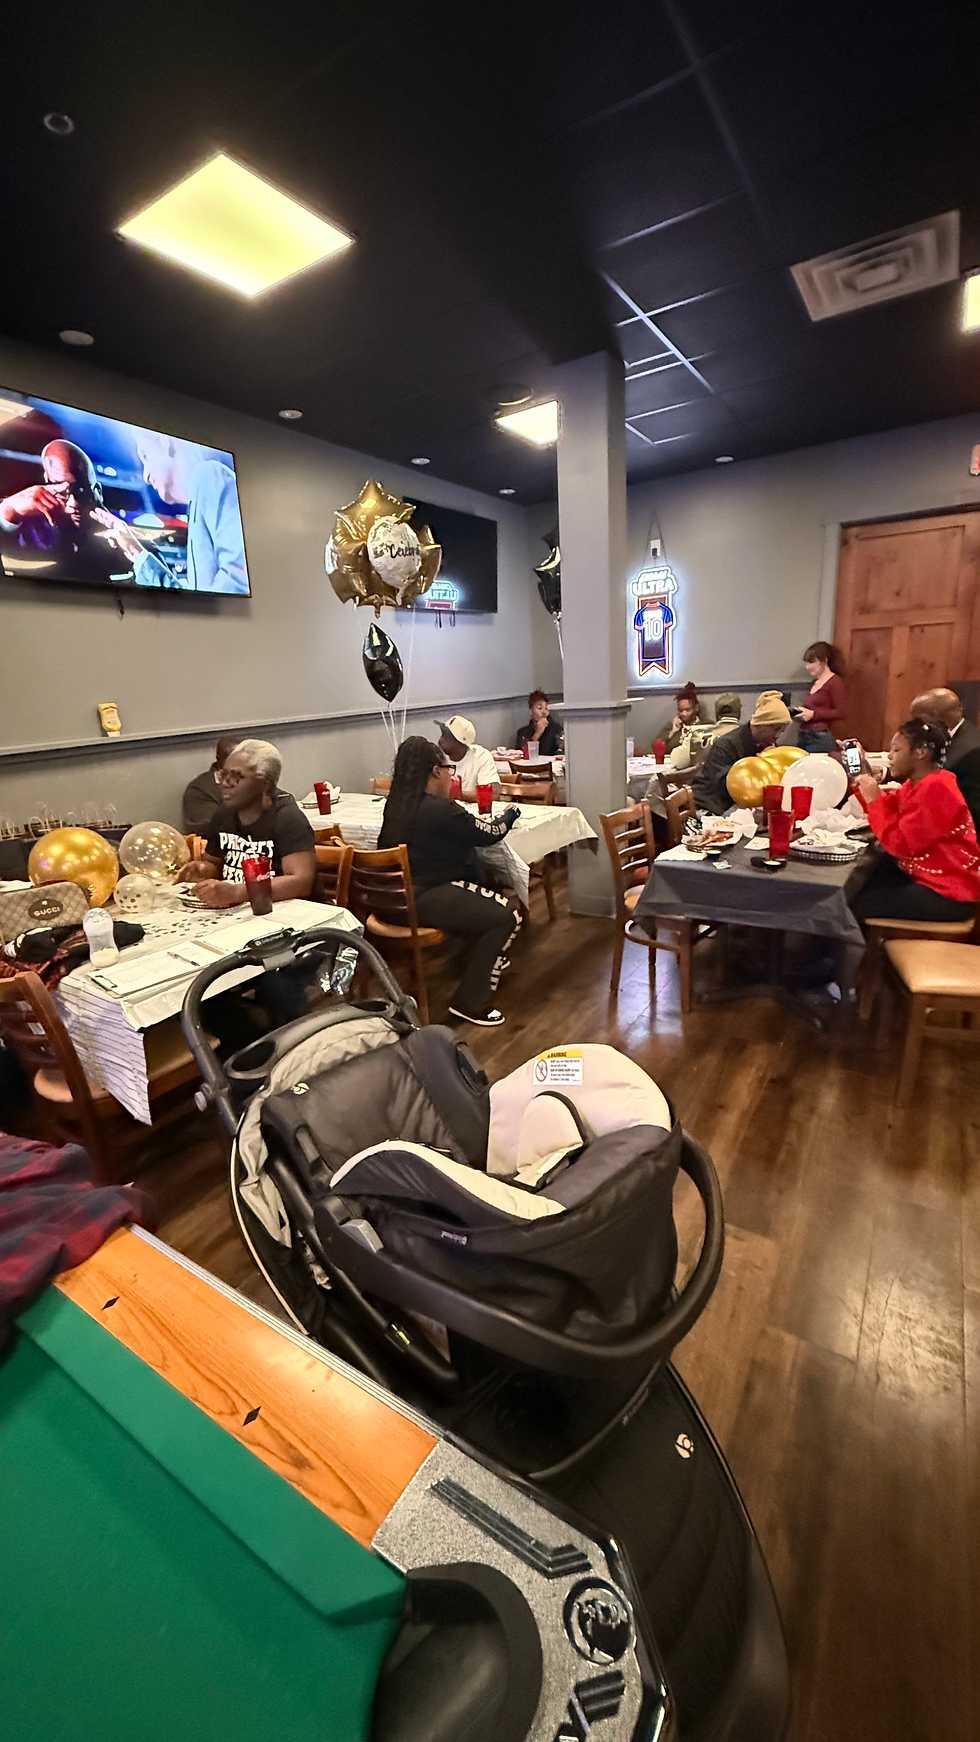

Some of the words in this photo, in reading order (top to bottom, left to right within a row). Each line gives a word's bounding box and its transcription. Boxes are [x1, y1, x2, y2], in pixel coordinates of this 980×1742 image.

[632, 577, 675, 596] ULTRA
[643, 618, 664, 642] 10
[33, 906, 61, 917] GUCCI
